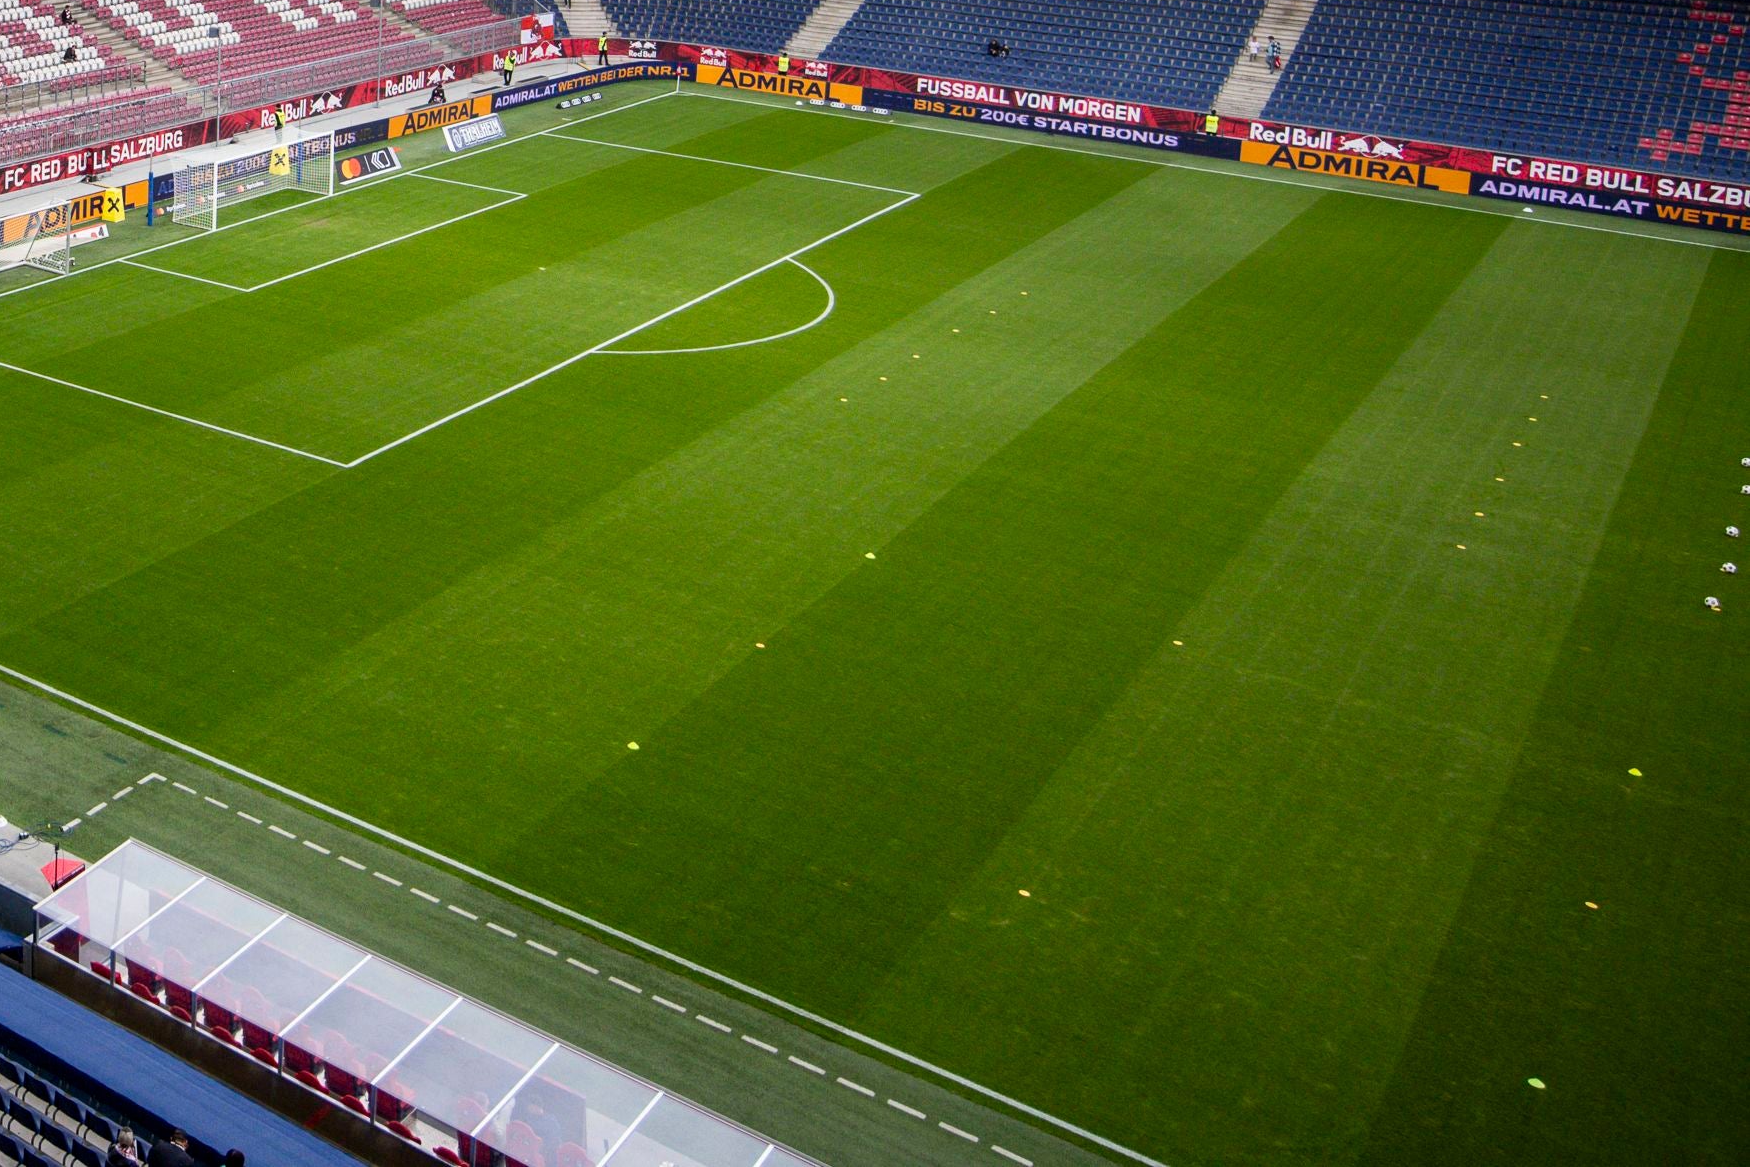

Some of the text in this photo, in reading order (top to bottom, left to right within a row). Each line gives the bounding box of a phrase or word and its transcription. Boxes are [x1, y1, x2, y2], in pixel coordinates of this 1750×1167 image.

[628, 49, 657, 58] Red Bull
[700, 55, 727, 67] Red Bull
[385, 70, 425, 97] Red Bull
[495, 82, 557, 109] ADMIRAL.AT
[558, 74, 599, 92] WETTEN
[600, 70, 616, 83] BEI
[618, 66, 643, 80] DER
[716, 65, 841, 102] ADMIRAL
[804, 67, 828, 78] Red Bull
[285, 99, 307, 121] Bull
[402, 98, 480, 136] ADMIRAL
[916, 77, 1142, 123] FUSSBALL VON MORGEN
[913, 98, 1179, 148] BIS ZU 200€ STARTBONUS
[1250, 122, 1332, 150] Red Bull
[4, 168, 24, 190] FC
[31, 159, 61, 184] RED
[111, 130, 183, 164] SALZBURG
[1267, 144, 1440, 191] ADMIRAL
[1491, 155, 1522, 177] FC
[1529, 160, 1578, 184] RED
[1585, 168, 1650, 194] BULL
[1479, 180, 1650, 216] ADMIRAL.AT
